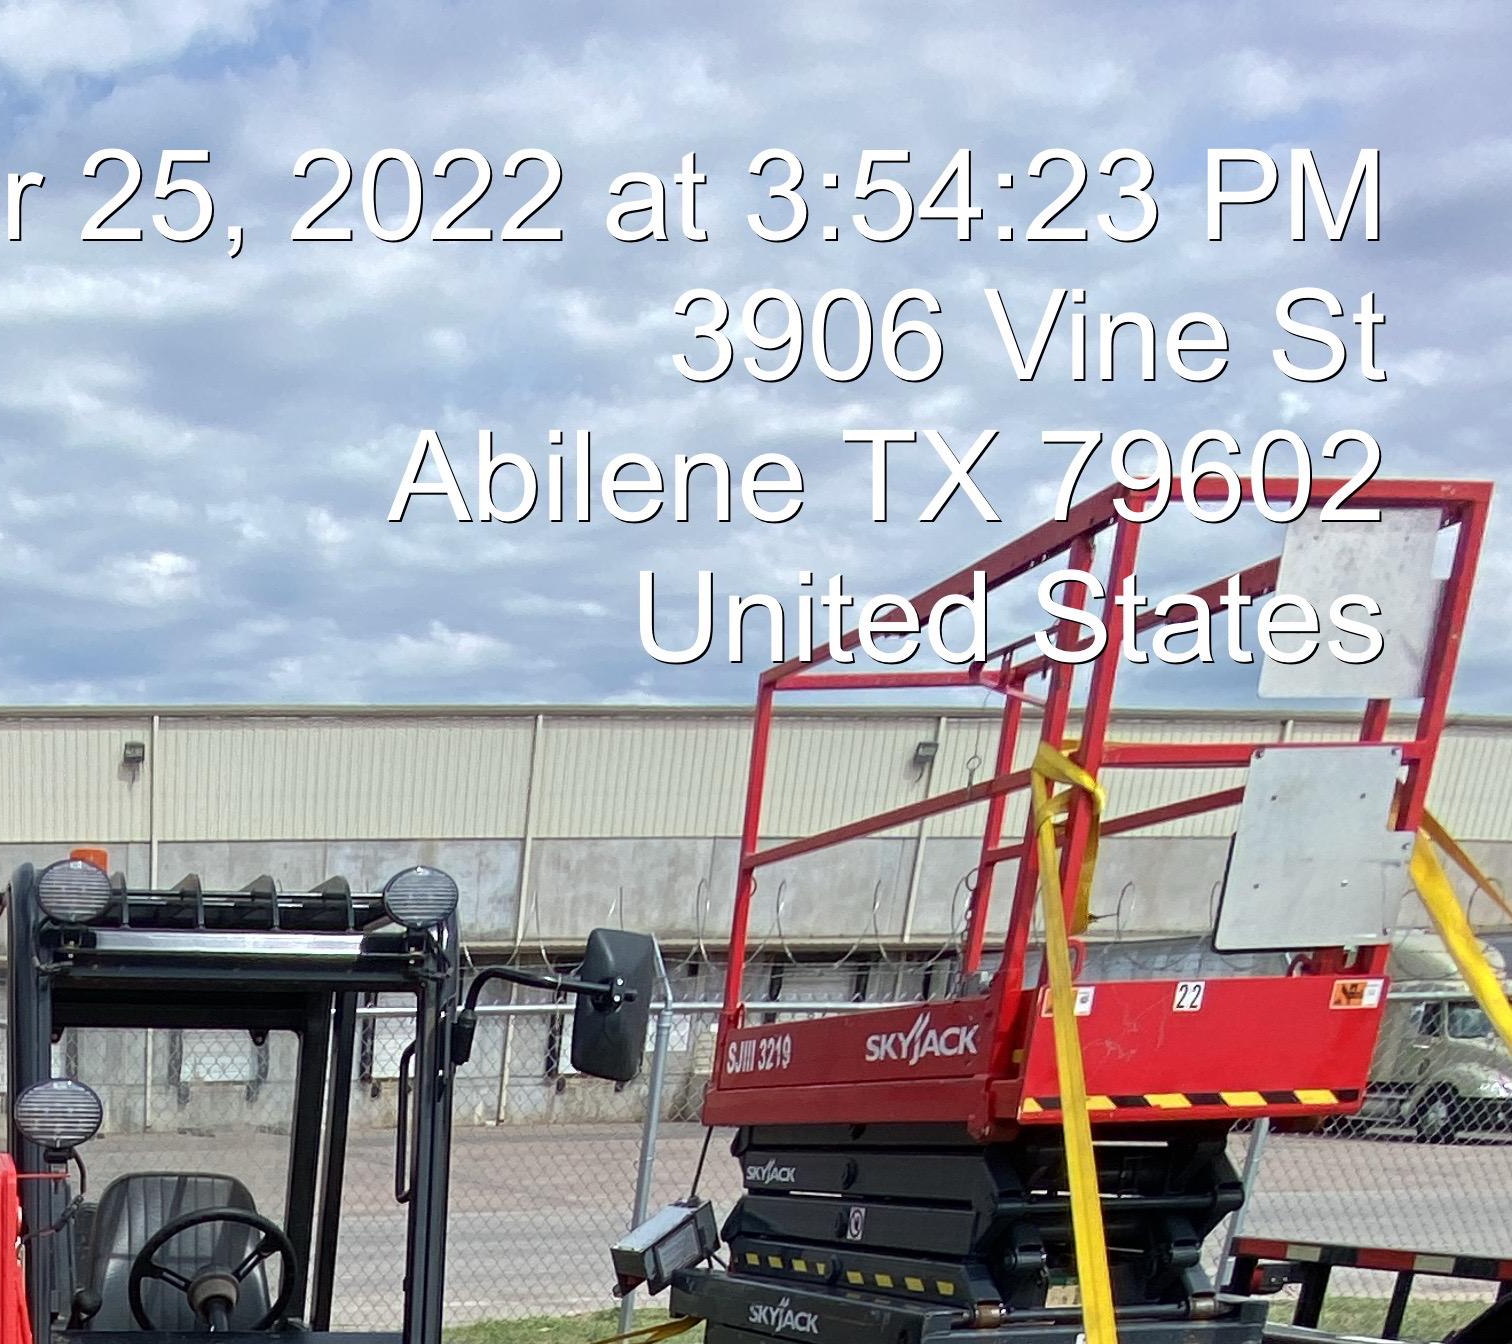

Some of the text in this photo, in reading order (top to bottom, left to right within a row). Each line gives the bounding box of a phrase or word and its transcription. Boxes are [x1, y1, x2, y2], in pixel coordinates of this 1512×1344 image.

[726, 1033, 792, 1075] SJIII 3219
[865, 1011, 980, 1067] SKYJACK
[745, 1159, 796, 1184] SKYJACK
[748, 1296, 819, 1334] SKYJACK
